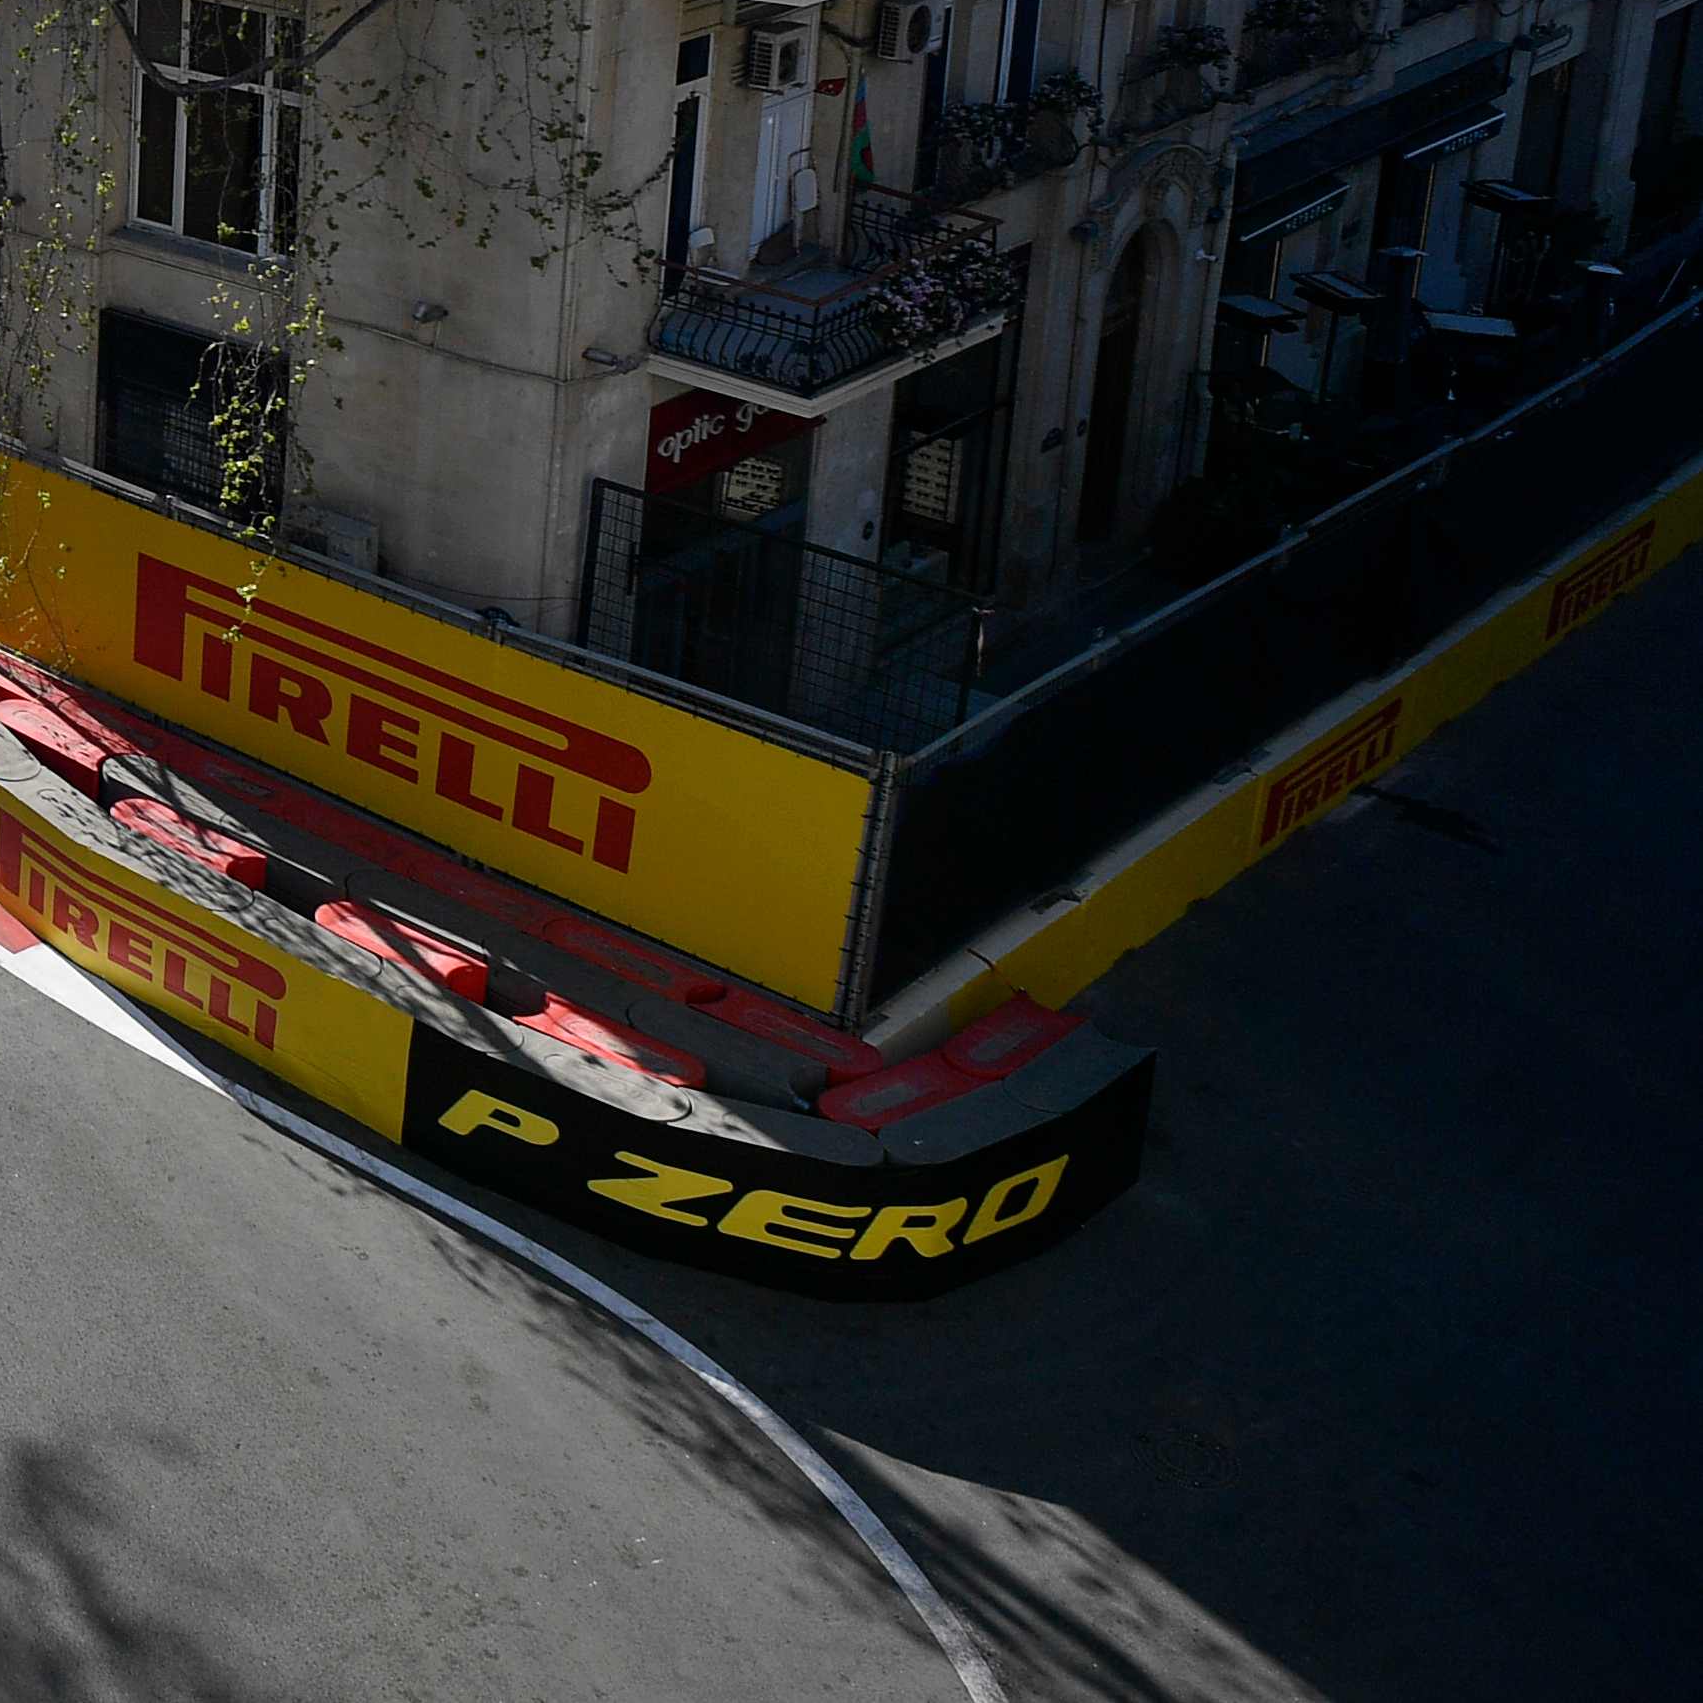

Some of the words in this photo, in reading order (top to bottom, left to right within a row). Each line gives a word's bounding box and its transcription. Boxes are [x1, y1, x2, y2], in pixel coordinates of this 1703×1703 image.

[657, 413, 726, 464] optic
[1546, 520, 1656, 640] PIRELLI
[133, 552, 652, 874] PIRELLI
[1260, 696, 1403, 847] PIRELLI
[437, 1088, 561, 1146] P
[586, 1150, 1069, 1261] ZERO
